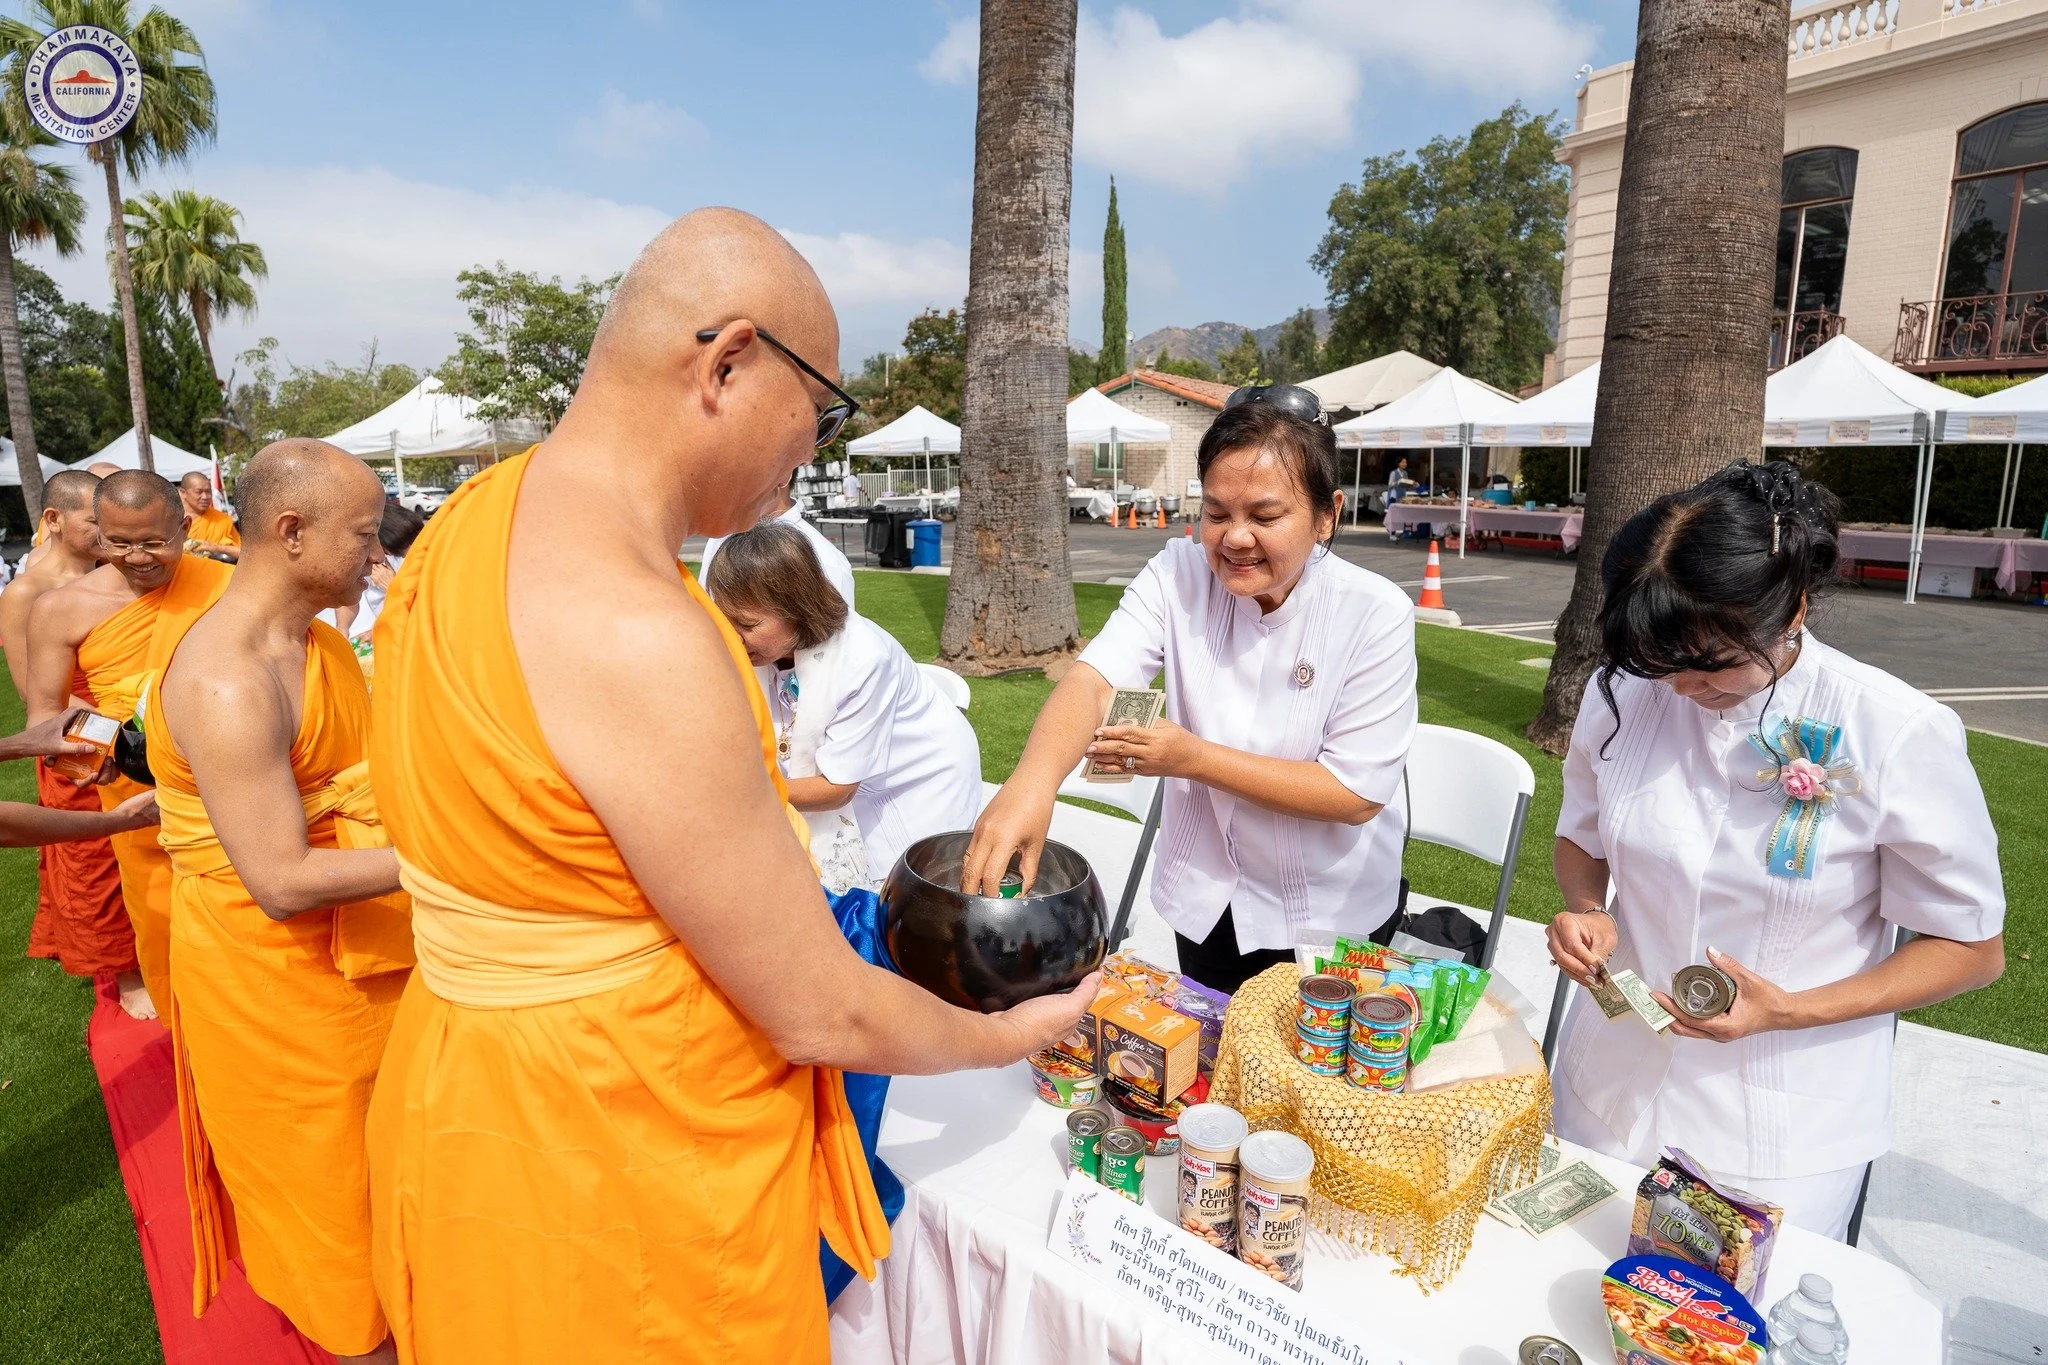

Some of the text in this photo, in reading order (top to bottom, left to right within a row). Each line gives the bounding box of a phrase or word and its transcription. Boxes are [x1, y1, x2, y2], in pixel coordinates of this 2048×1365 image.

[1343, 950, 1385, 969] MAMA
[1120, 1034, 1146, 1051] Coffee
[1262, 1227, 1302, 1241] COFFEE
[1264, 1216, 1302, 1231] PEANUTS
[1653, 1212, 1715, 1251] 10 Nut
[1113, 1215, 1138, 1240] กัลฯ
[1237, 1288, 1290, 1326] พระวิชัย
[1117, 1264, 1141, 1290] กัลฯ
[1636, 1266, 1697, 1299] Bowl
[1110, 1239, 1177, 1284] พระนิรันดร์
[1216, 1298, 1243, 1326] กัลฯ
[1246, 1320, 1279, 1346] ถาวร
[1627, 1273, 1719, 1319] Noodles
[1685, 1279, 1721, 1298] NONGSHIM
[1678, 1312, 1699, 1326] Hot
[1701, 1320, 1709, 1329] &
[1711, 1324, 1743, 1341] Spicy
